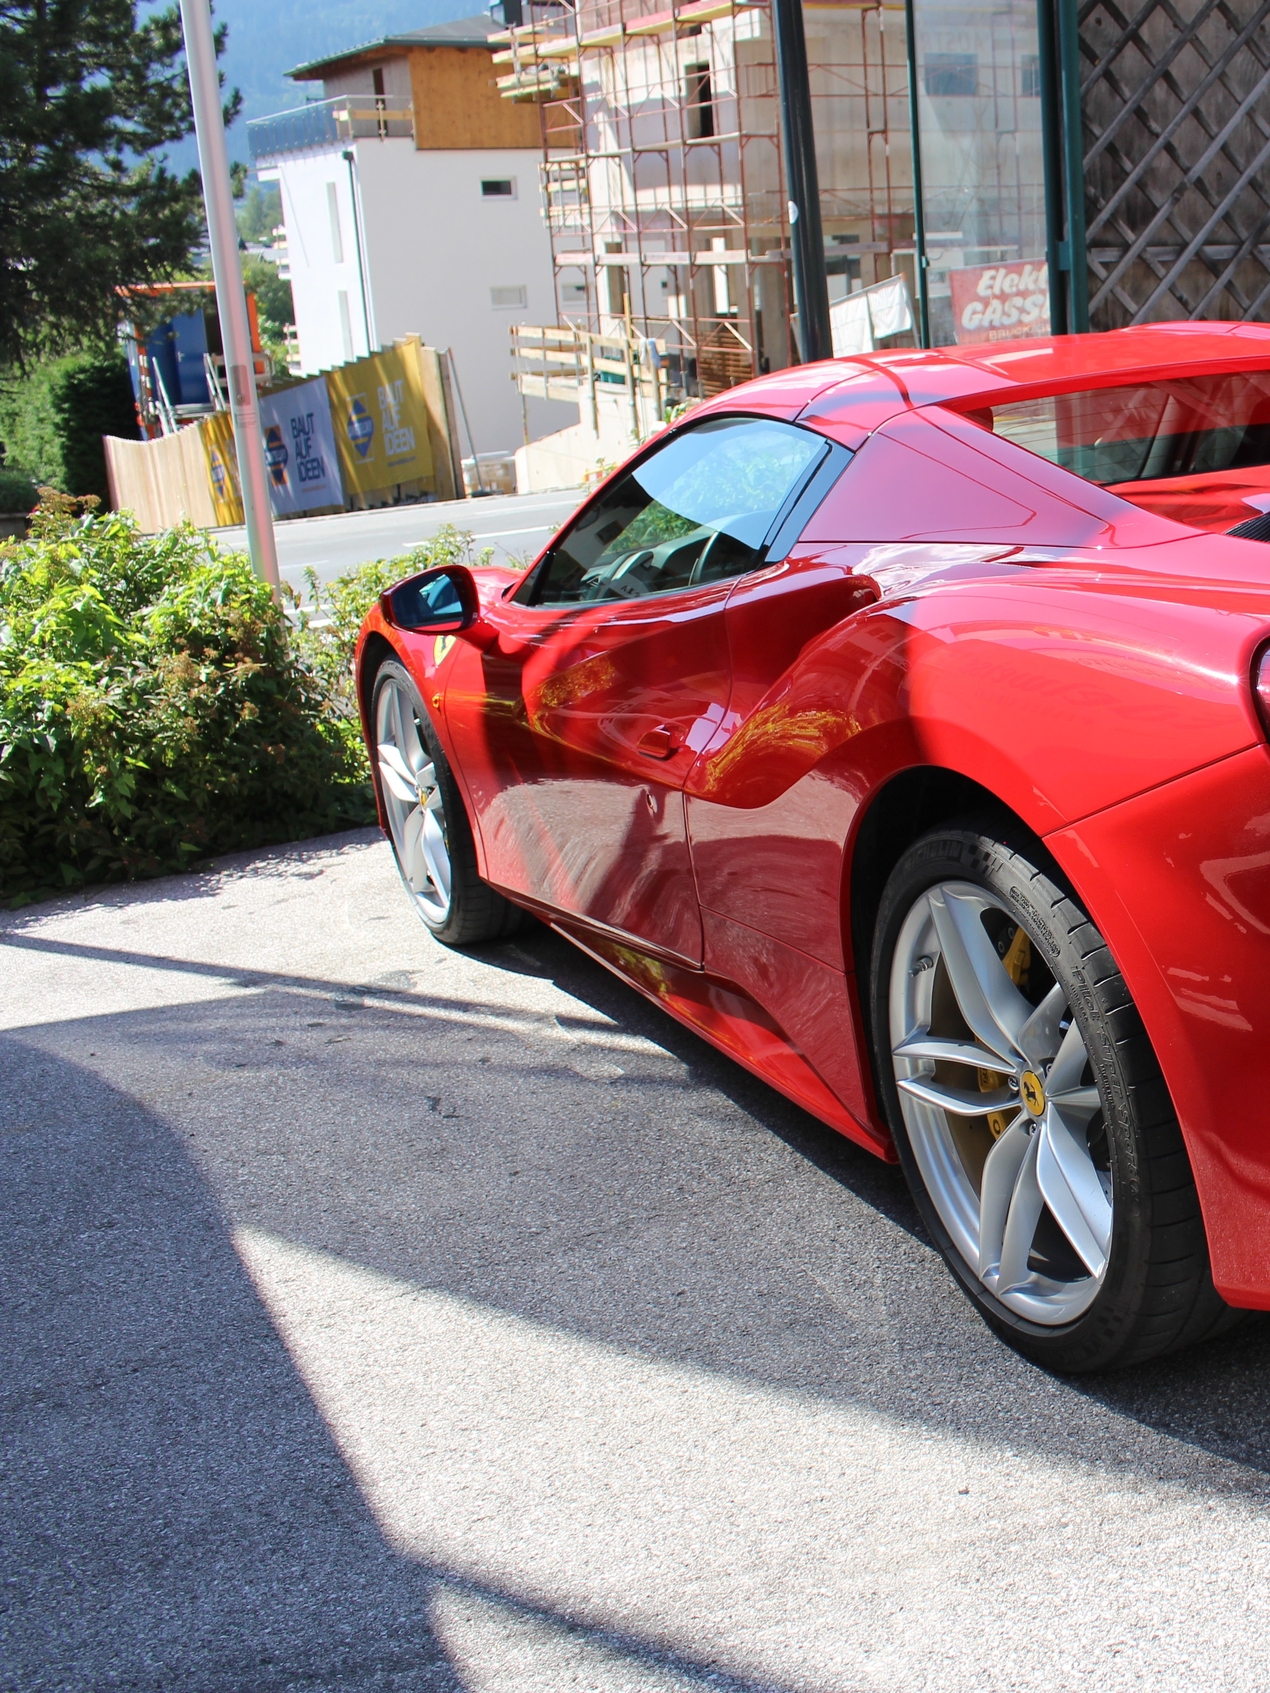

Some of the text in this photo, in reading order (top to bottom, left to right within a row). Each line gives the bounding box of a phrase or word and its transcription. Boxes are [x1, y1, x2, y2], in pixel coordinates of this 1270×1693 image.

[961, 293, 1051, 331] GASS
[377, 380, 404, 410] BAUT
[290, 412, 315, 439] BAUT
[382, 405, 401, 433] AUF
[295, 437, 312, 461] AUF
[383, 426, 416, 457] IDEEN
[297, 455, 327, 482] IDEEN
